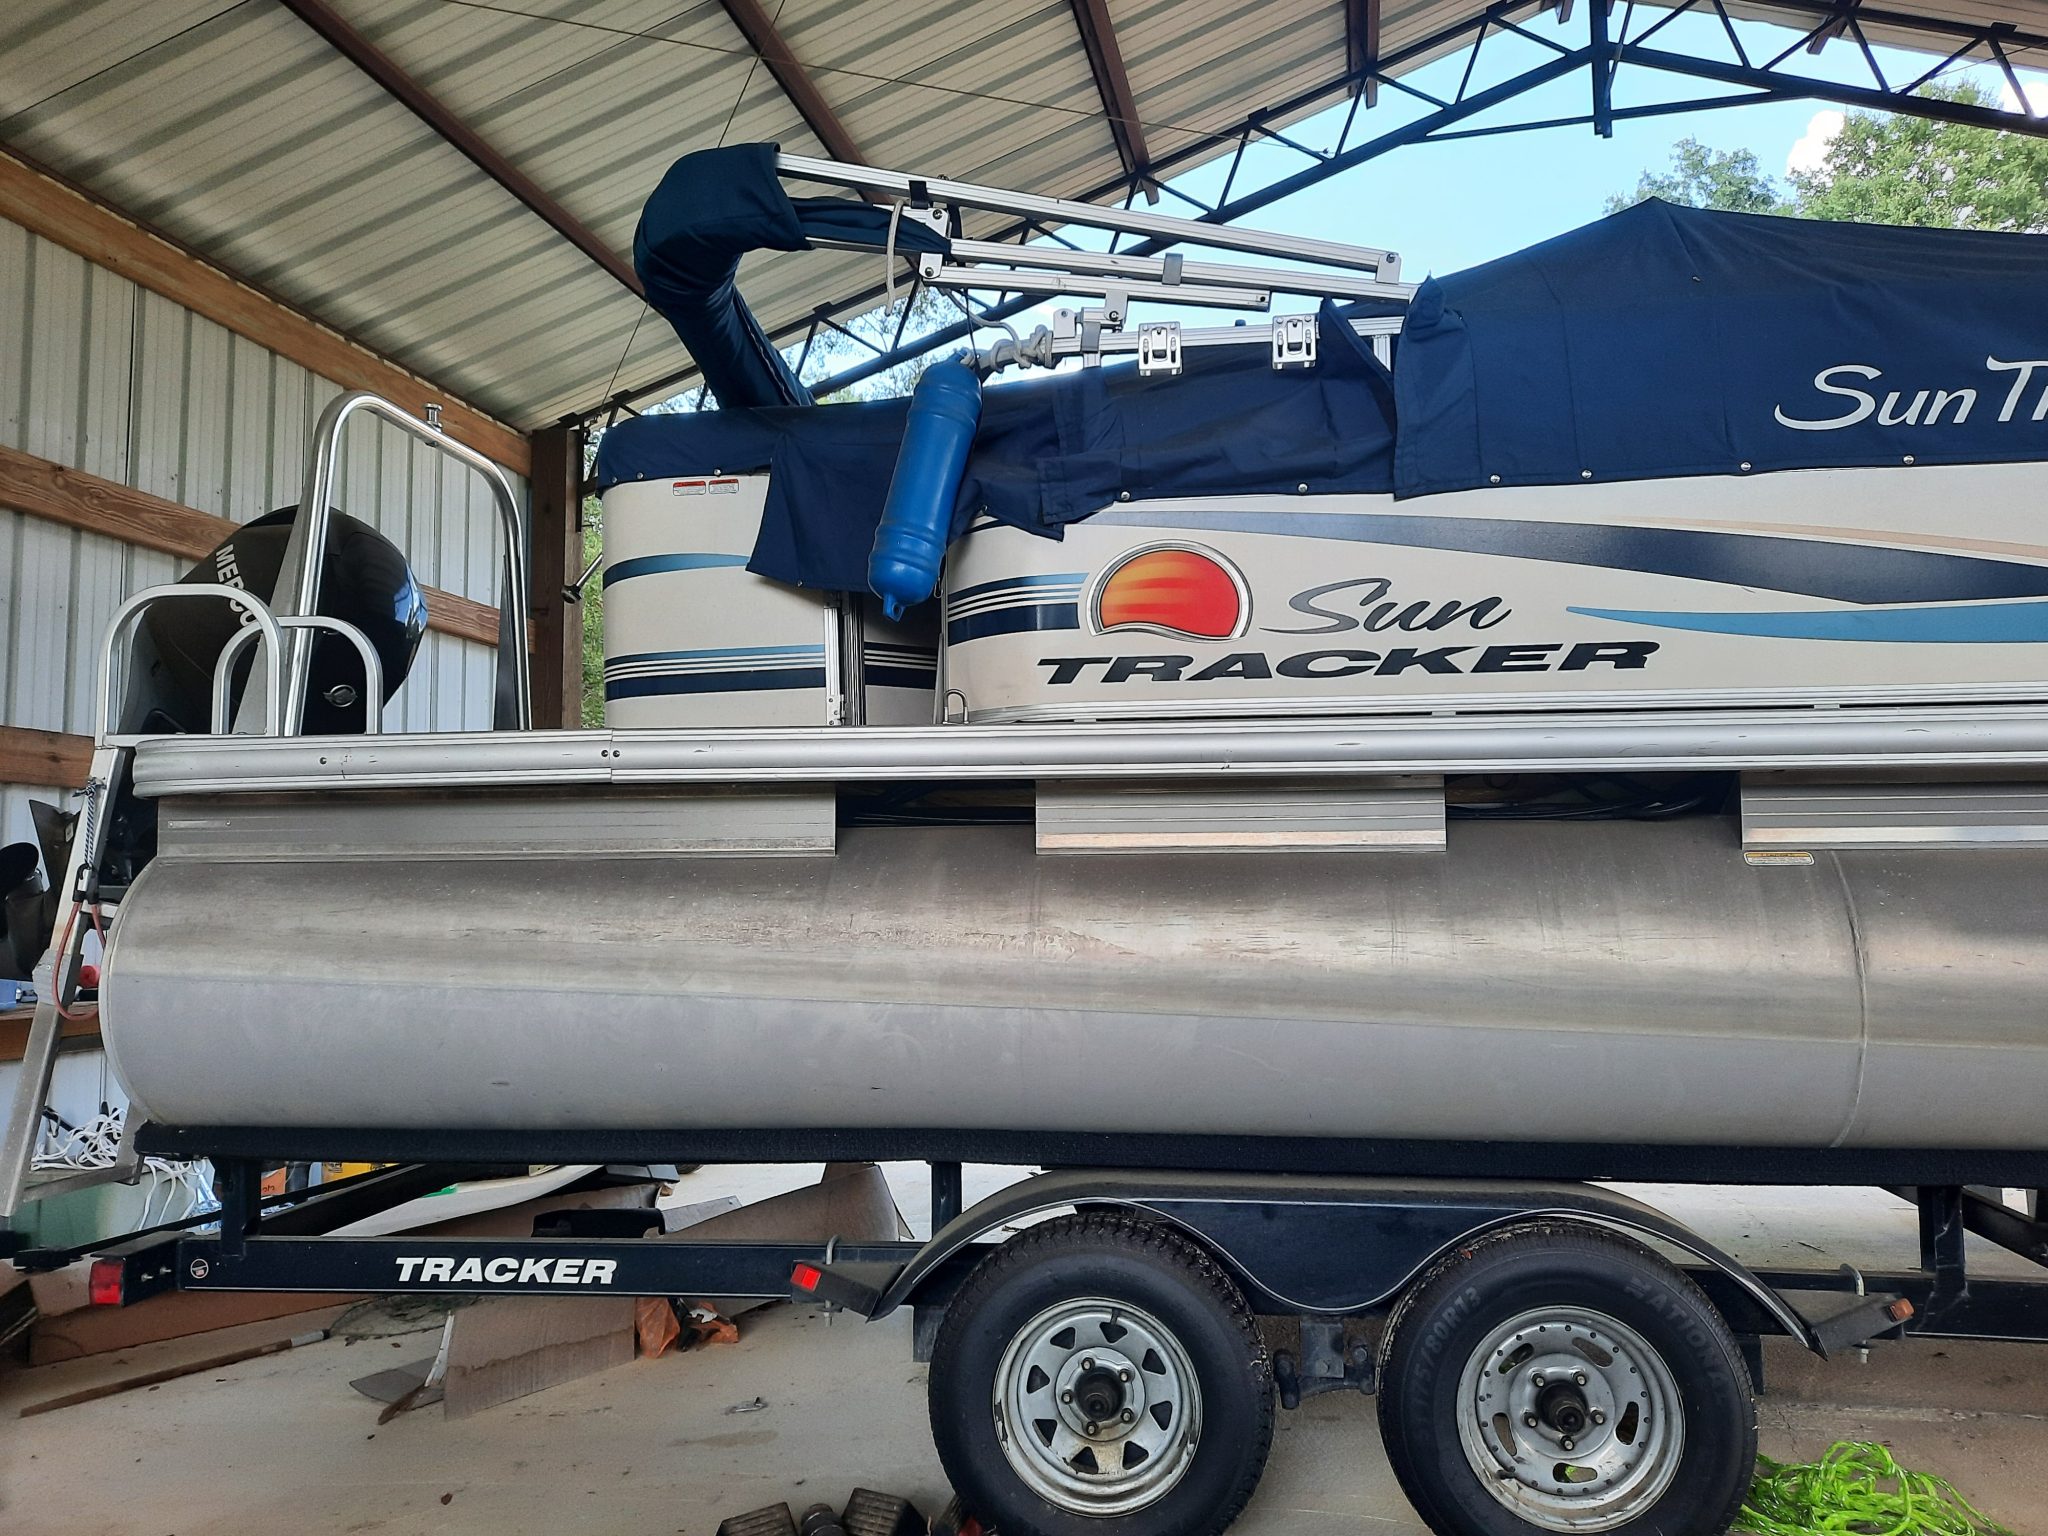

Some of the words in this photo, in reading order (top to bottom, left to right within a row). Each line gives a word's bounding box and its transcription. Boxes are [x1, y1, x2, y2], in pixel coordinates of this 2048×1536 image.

[1774, 364, 1977, 431] Sun
[1258, 578, 1513, 635] Sun
[1037, 641, 1661, 685] TRACKER
[395, 1257, 618, 1285] TRACKER
